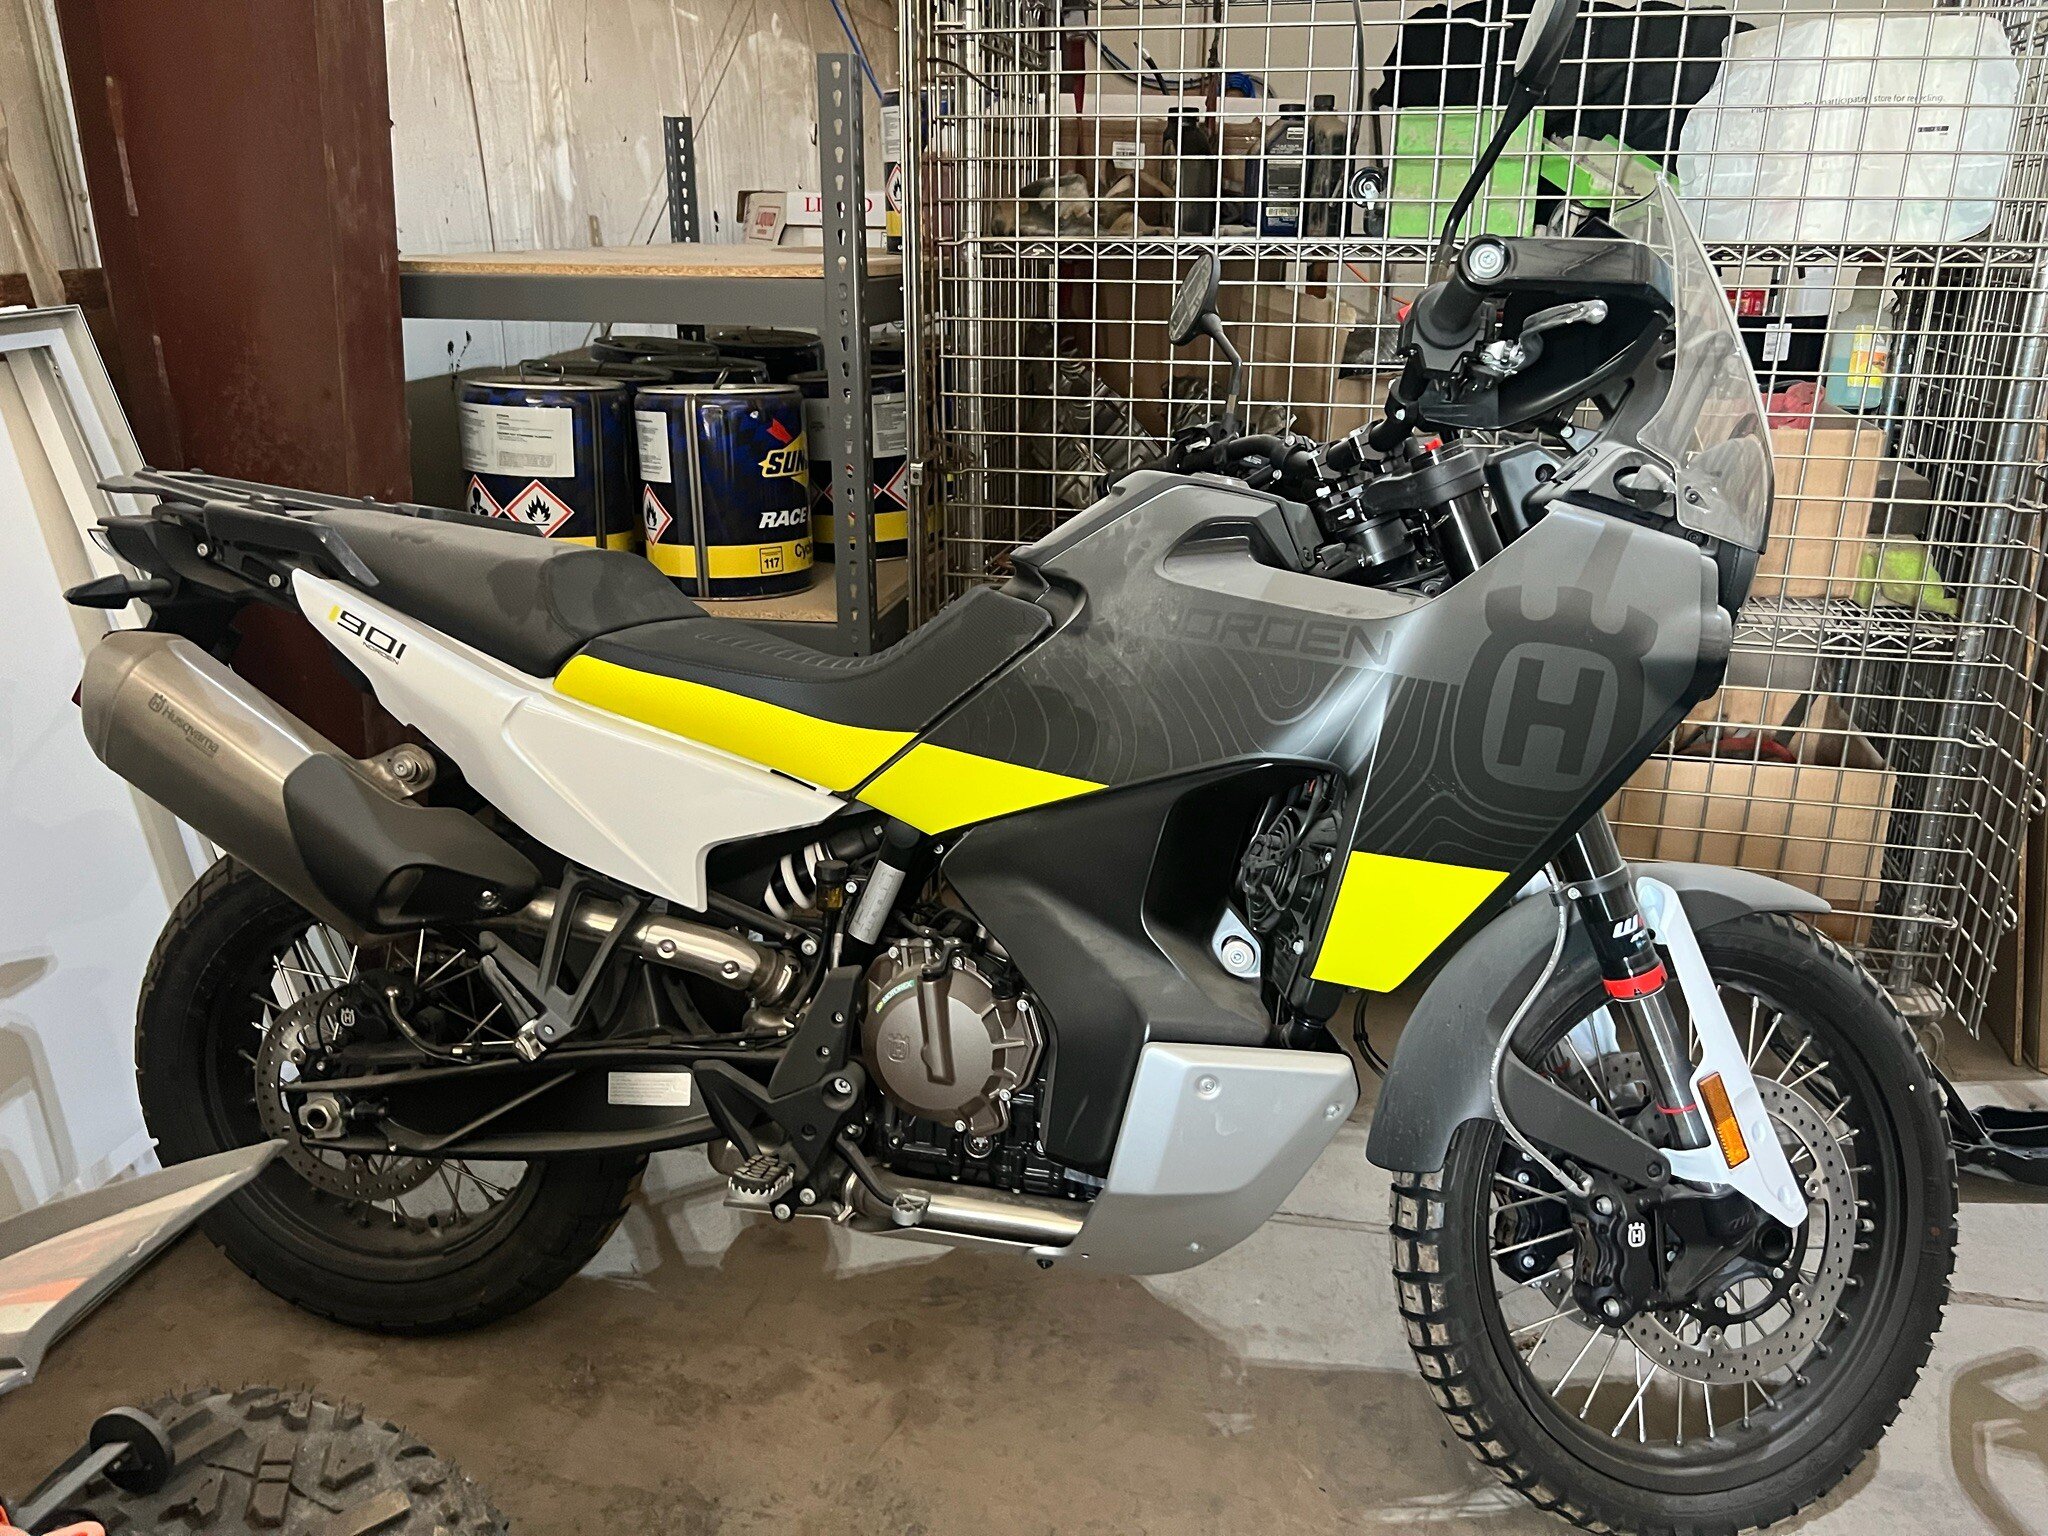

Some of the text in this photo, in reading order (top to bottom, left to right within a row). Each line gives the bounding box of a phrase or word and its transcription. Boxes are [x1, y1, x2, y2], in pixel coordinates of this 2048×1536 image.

[1893, 94, 1905, 102] for
[764, 558, 780, 570] 117
[337, 610, 407, 660] 901
